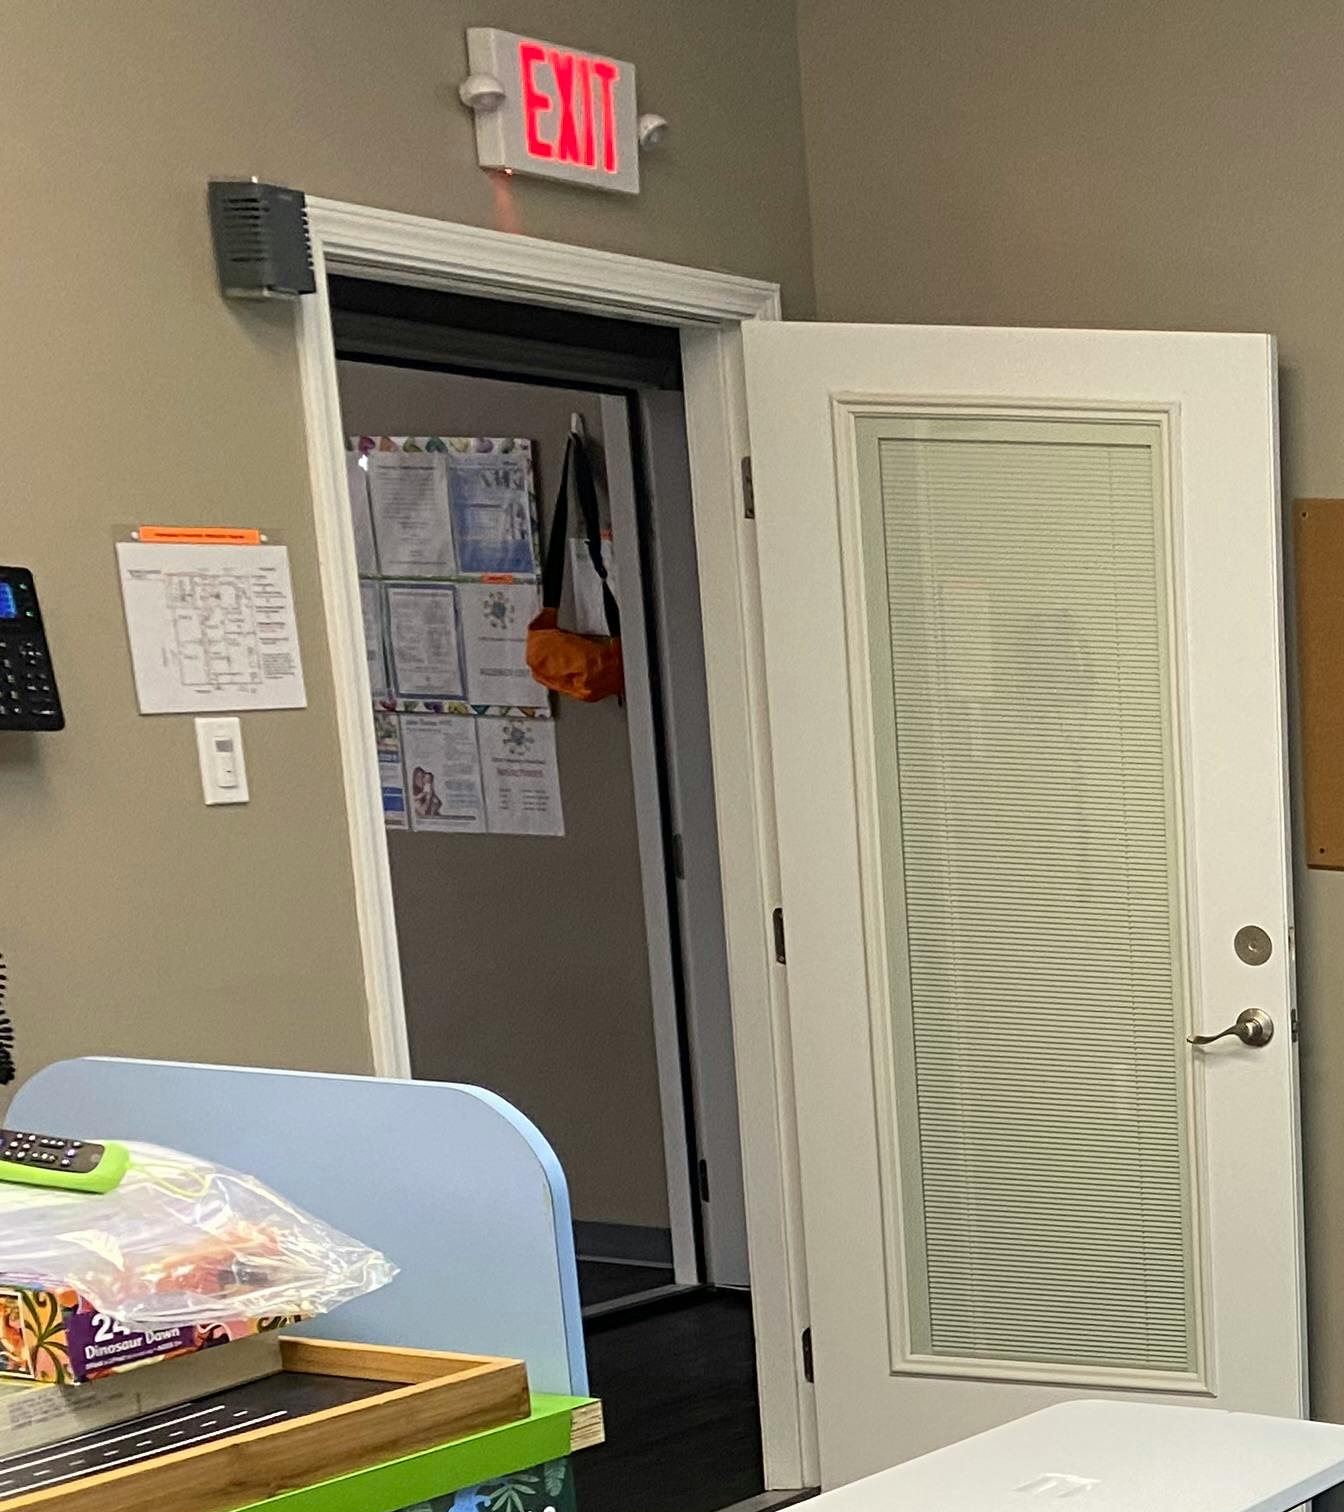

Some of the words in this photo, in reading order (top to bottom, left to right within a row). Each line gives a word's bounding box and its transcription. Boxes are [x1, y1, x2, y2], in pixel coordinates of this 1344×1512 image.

[519, 41, 619, 174] EXIT
[84, 1336, 143, 1360] Dinosaur
[146, 1328, 179, 1344] Dawn
